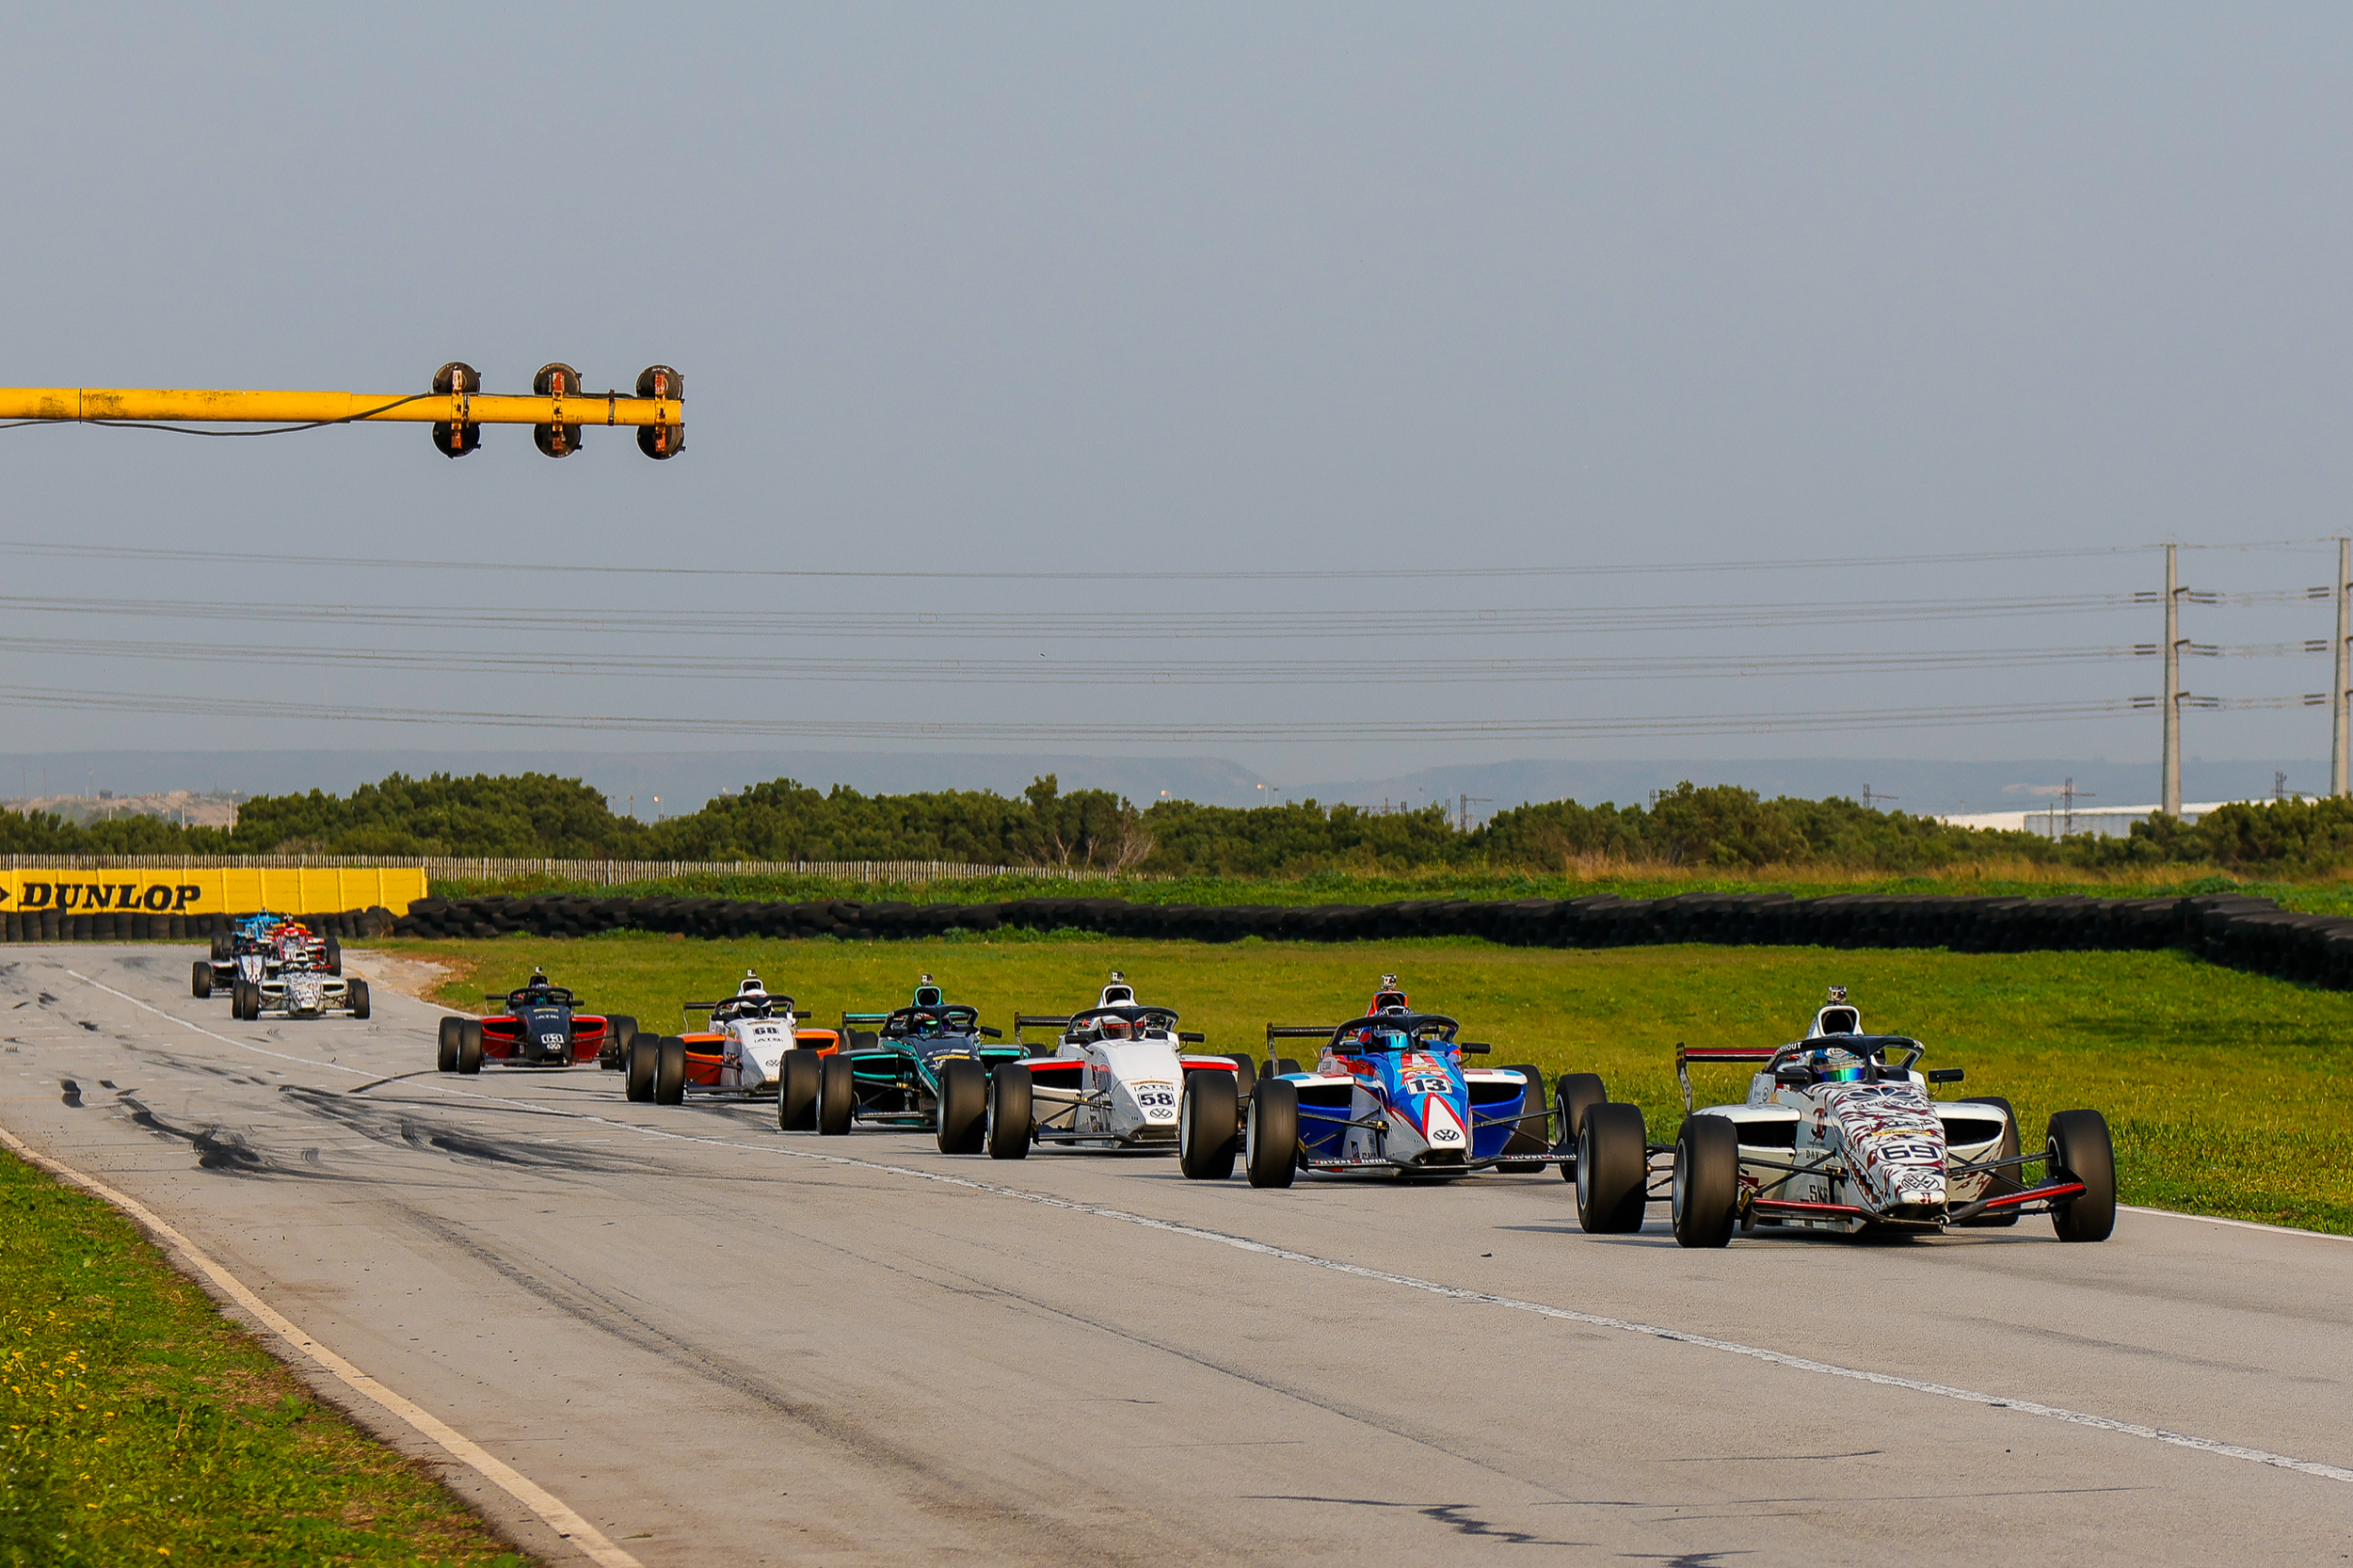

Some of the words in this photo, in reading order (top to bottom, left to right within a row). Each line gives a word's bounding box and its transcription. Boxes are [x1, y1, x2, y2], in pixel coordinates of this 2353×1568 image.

[18, 883, 201, 911] DUNLOP
[1410, 1079, 1447, 1092] 13
[1140, 1093, 1173, 1106] 58
[1881, 1145, 1939, 1160] 69
